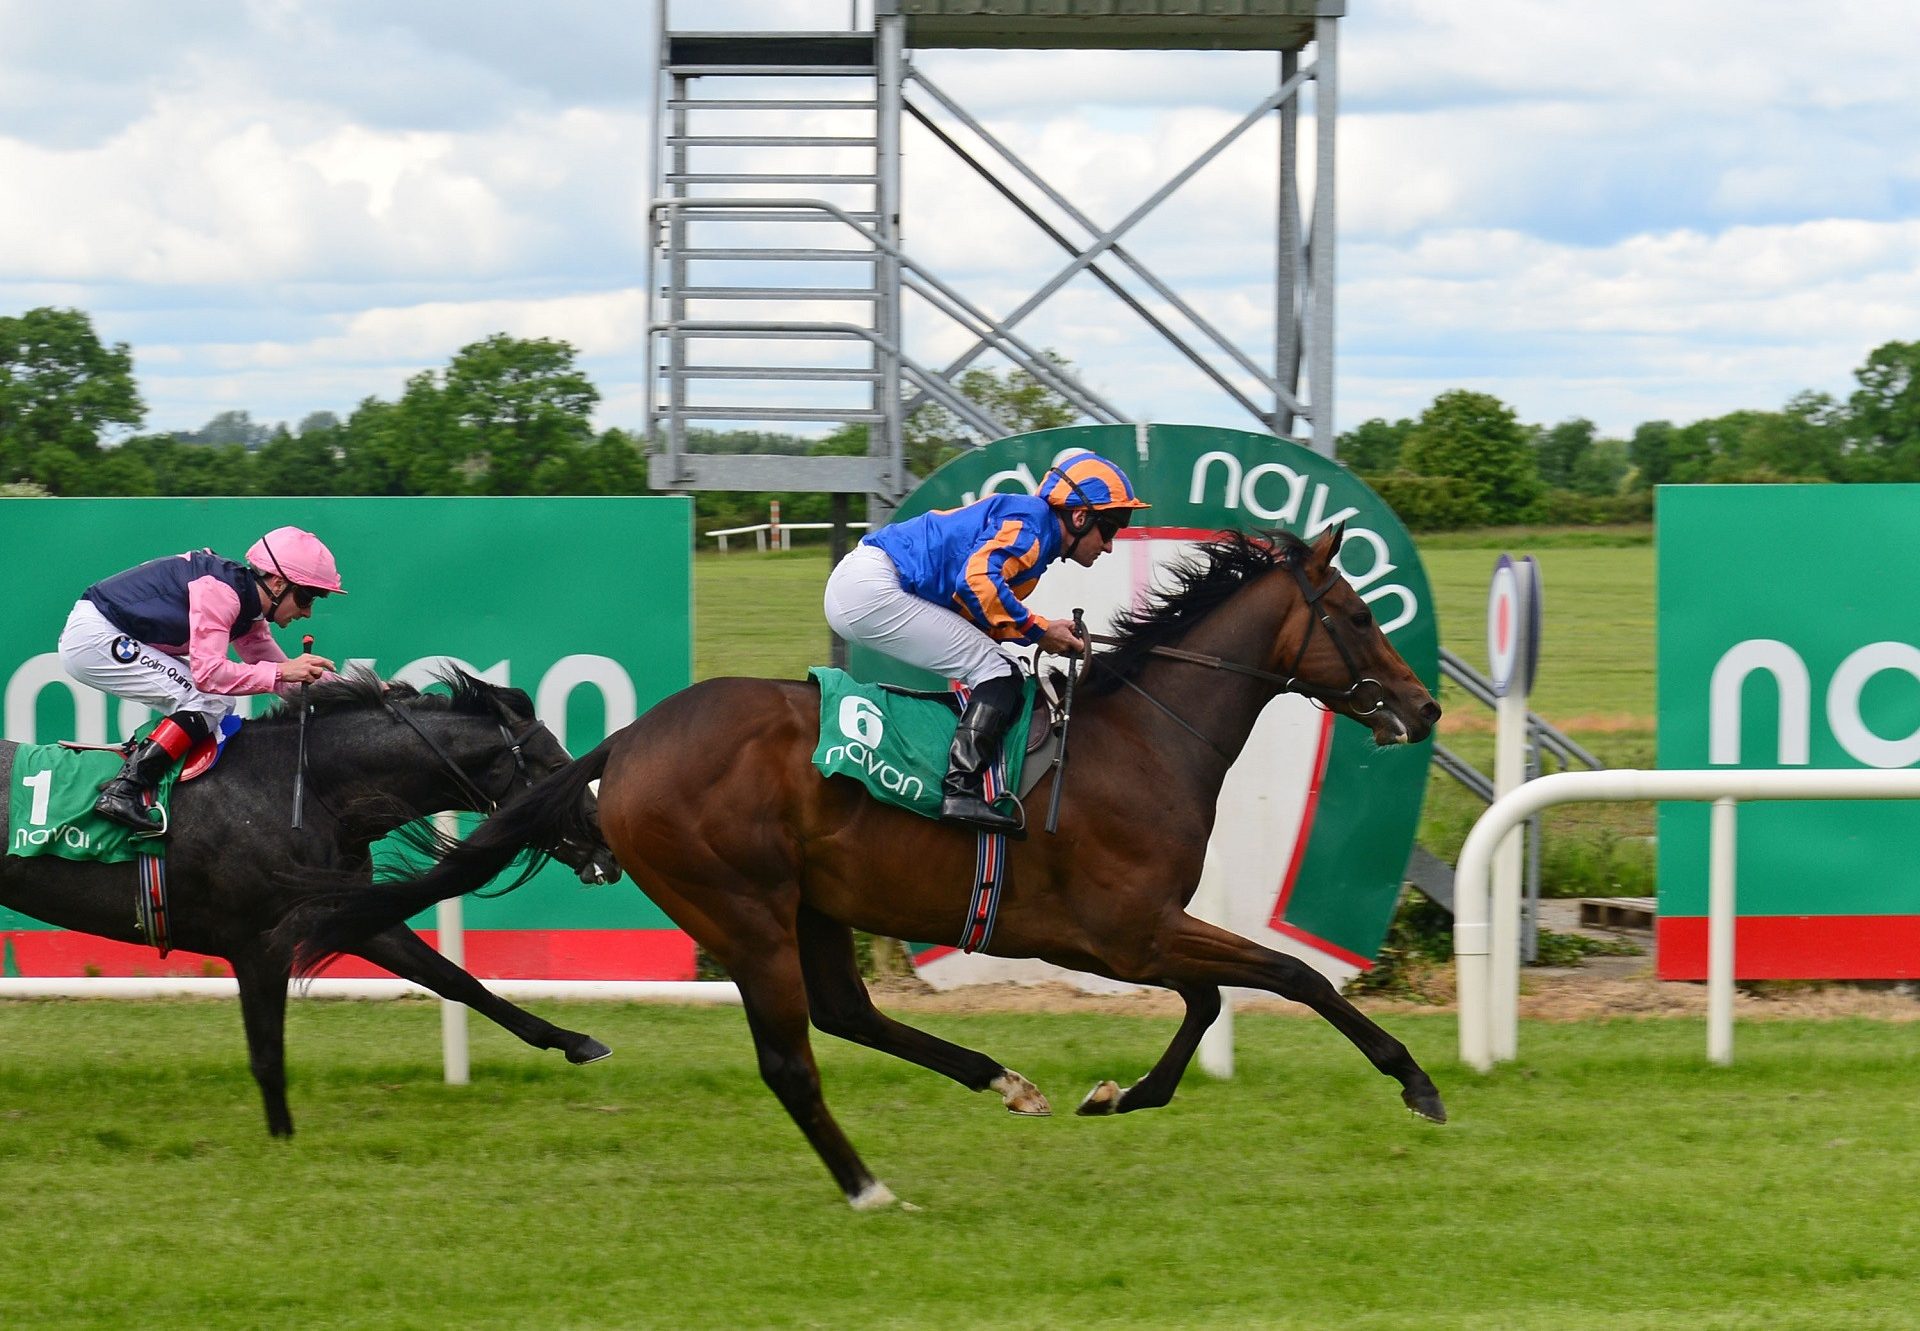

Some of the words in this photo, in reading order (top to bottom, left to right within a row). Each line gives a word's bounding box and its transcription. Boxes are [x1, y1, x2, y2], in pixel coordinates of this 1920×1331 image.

[1189, 451, 1418, 635] navan
[140, 655, 167, 673] Colm
[167, 667, 193, 692] Quinn
[839, 695, 883, 750] 6
[22, 769, 52, 825] 1
[825, 742, 924, 801] navan
